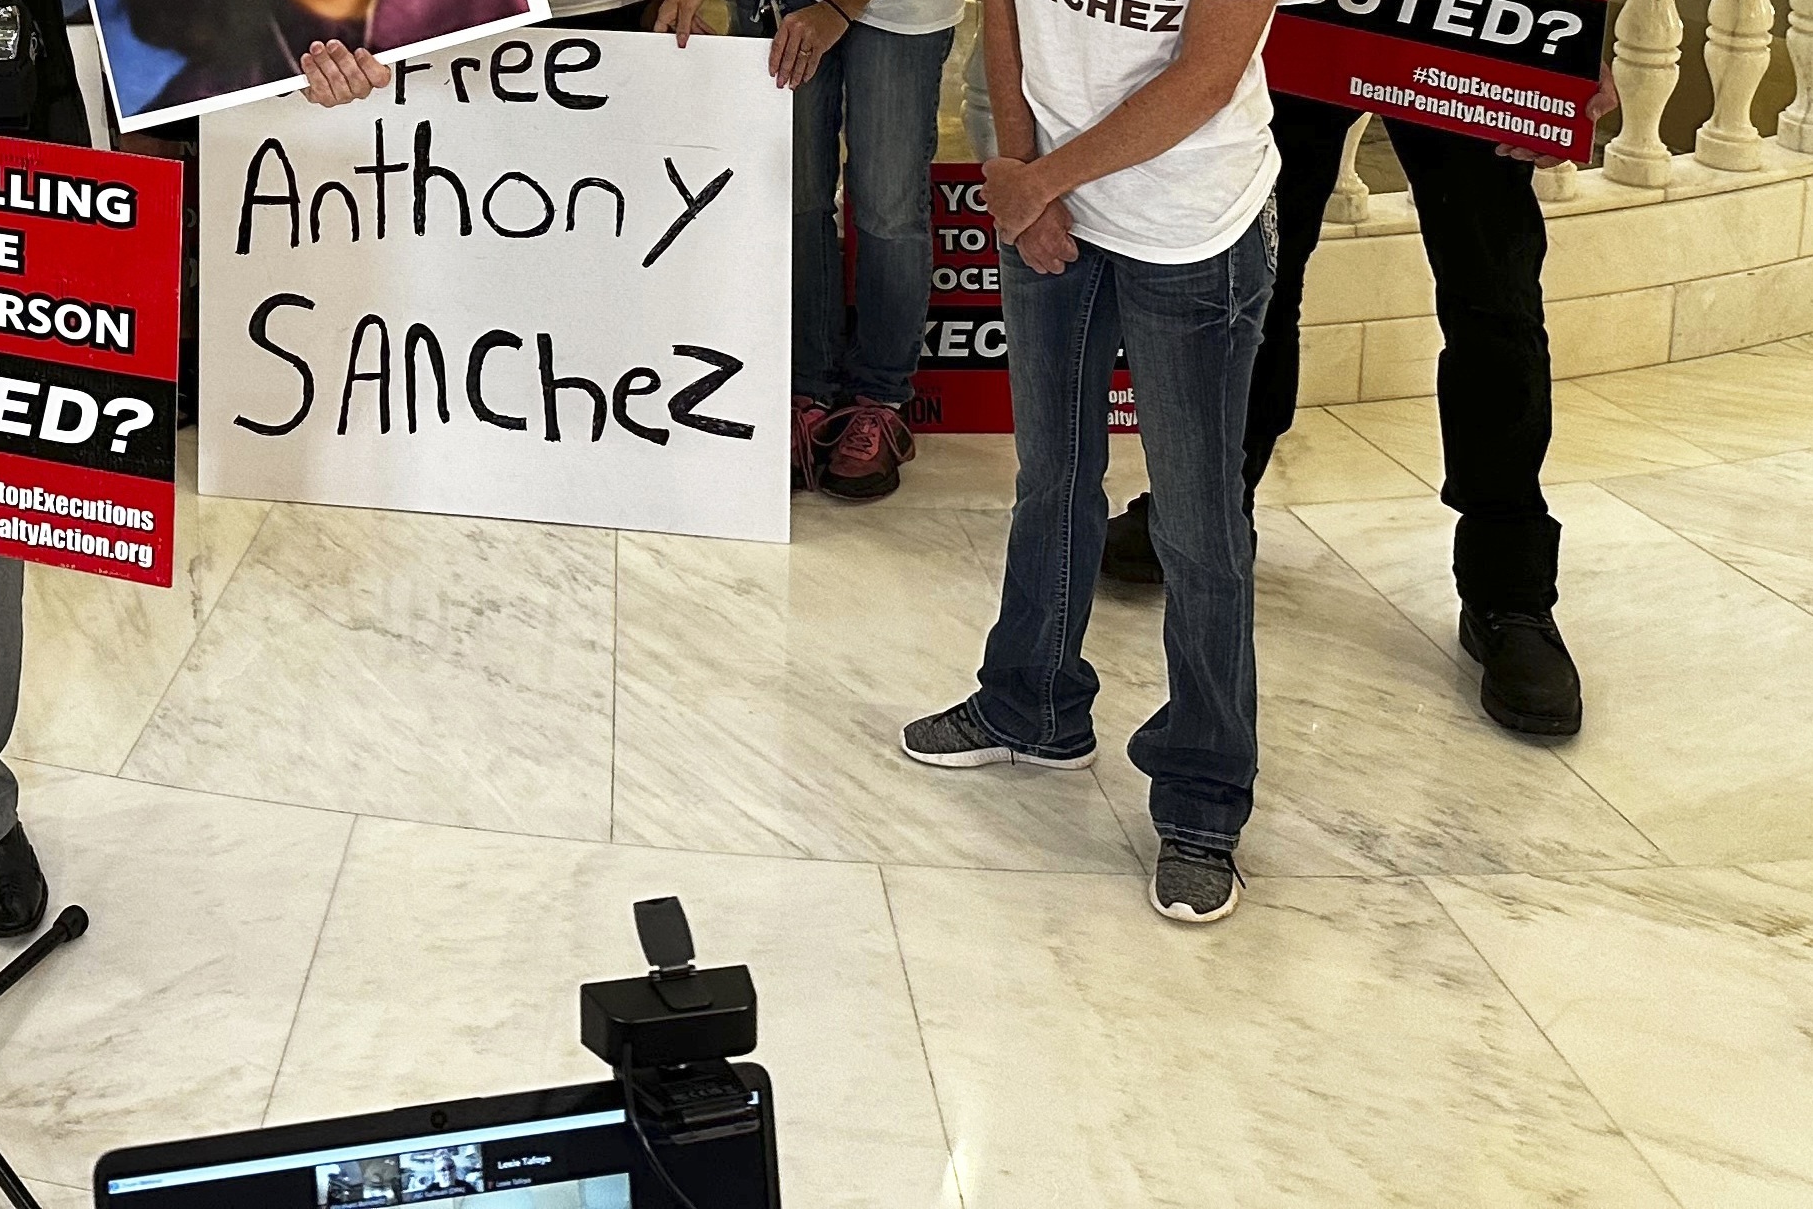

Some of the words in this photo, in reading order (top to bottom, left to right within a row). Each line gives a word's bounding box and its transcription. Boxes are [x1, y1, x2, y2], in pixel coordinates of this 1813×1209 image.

[1350, 77, 1573, 146] DeathPenaltyAction.org
[1413, 67, 1575, 118] #StopExecutions
[236, 119, 734, 268] Anthony
[940, 185, 988, 211] YO
[939, 229, 986, 250] TO
